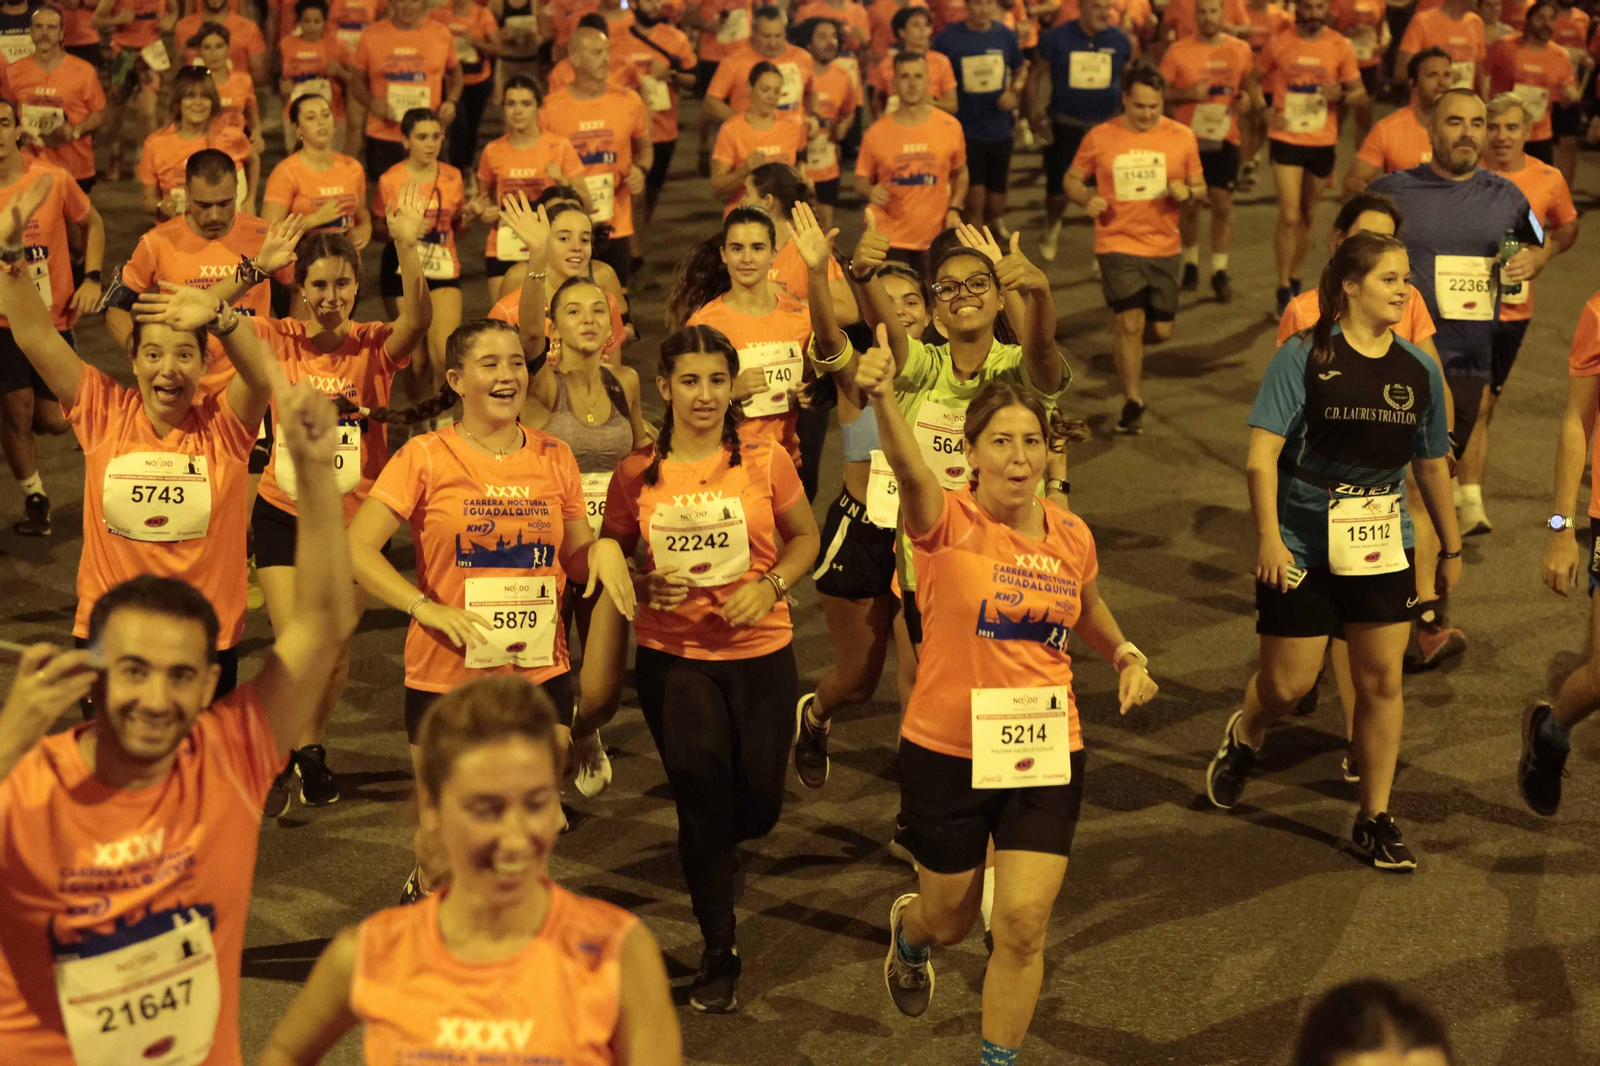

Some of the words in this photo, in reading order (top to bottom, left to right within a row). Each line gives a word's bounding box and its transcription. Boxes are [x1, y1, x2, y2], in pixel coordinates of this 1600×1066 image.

[200, 265, 237, 277] XXXV
[1449, 279, 1491, 293] 22363
[766, 367, 792, 384] 740
[1325, 406, 1341, 419] C.D.
[1343, 407, 1377, 420] LAURUS
[1378, 408, 1417, 425] TRIATLON
[933, 435, 964, 455] 564
[131, 485, 185, 504] 5743
[484, 483, 530, 499] XXXV
[672, 490, 723, 508] XXXV
[469, 508, 549, 516] GUADALQUIVIR
[507, 499, 547, 507] NOCTURNA
[666, 531, 729, 552] 22242
[1347, 523, 1390, 541] 15112
[1013, 553, 1062, 575] XXXV
[993, 564, 1034, 579] CARRERA
[1036, 573, 1078, 587] NOCTURNA
[999, 574, 1077, 598] GUADALQUIVIR
[493, 610, 537, 629] 5879
[1001, 723, 1047, 744] 5214
[94, 827, 165, 867] XXXV
[97, 978, 193, 1033] 21647
[433, 1016, 536, 1050] XXXV
